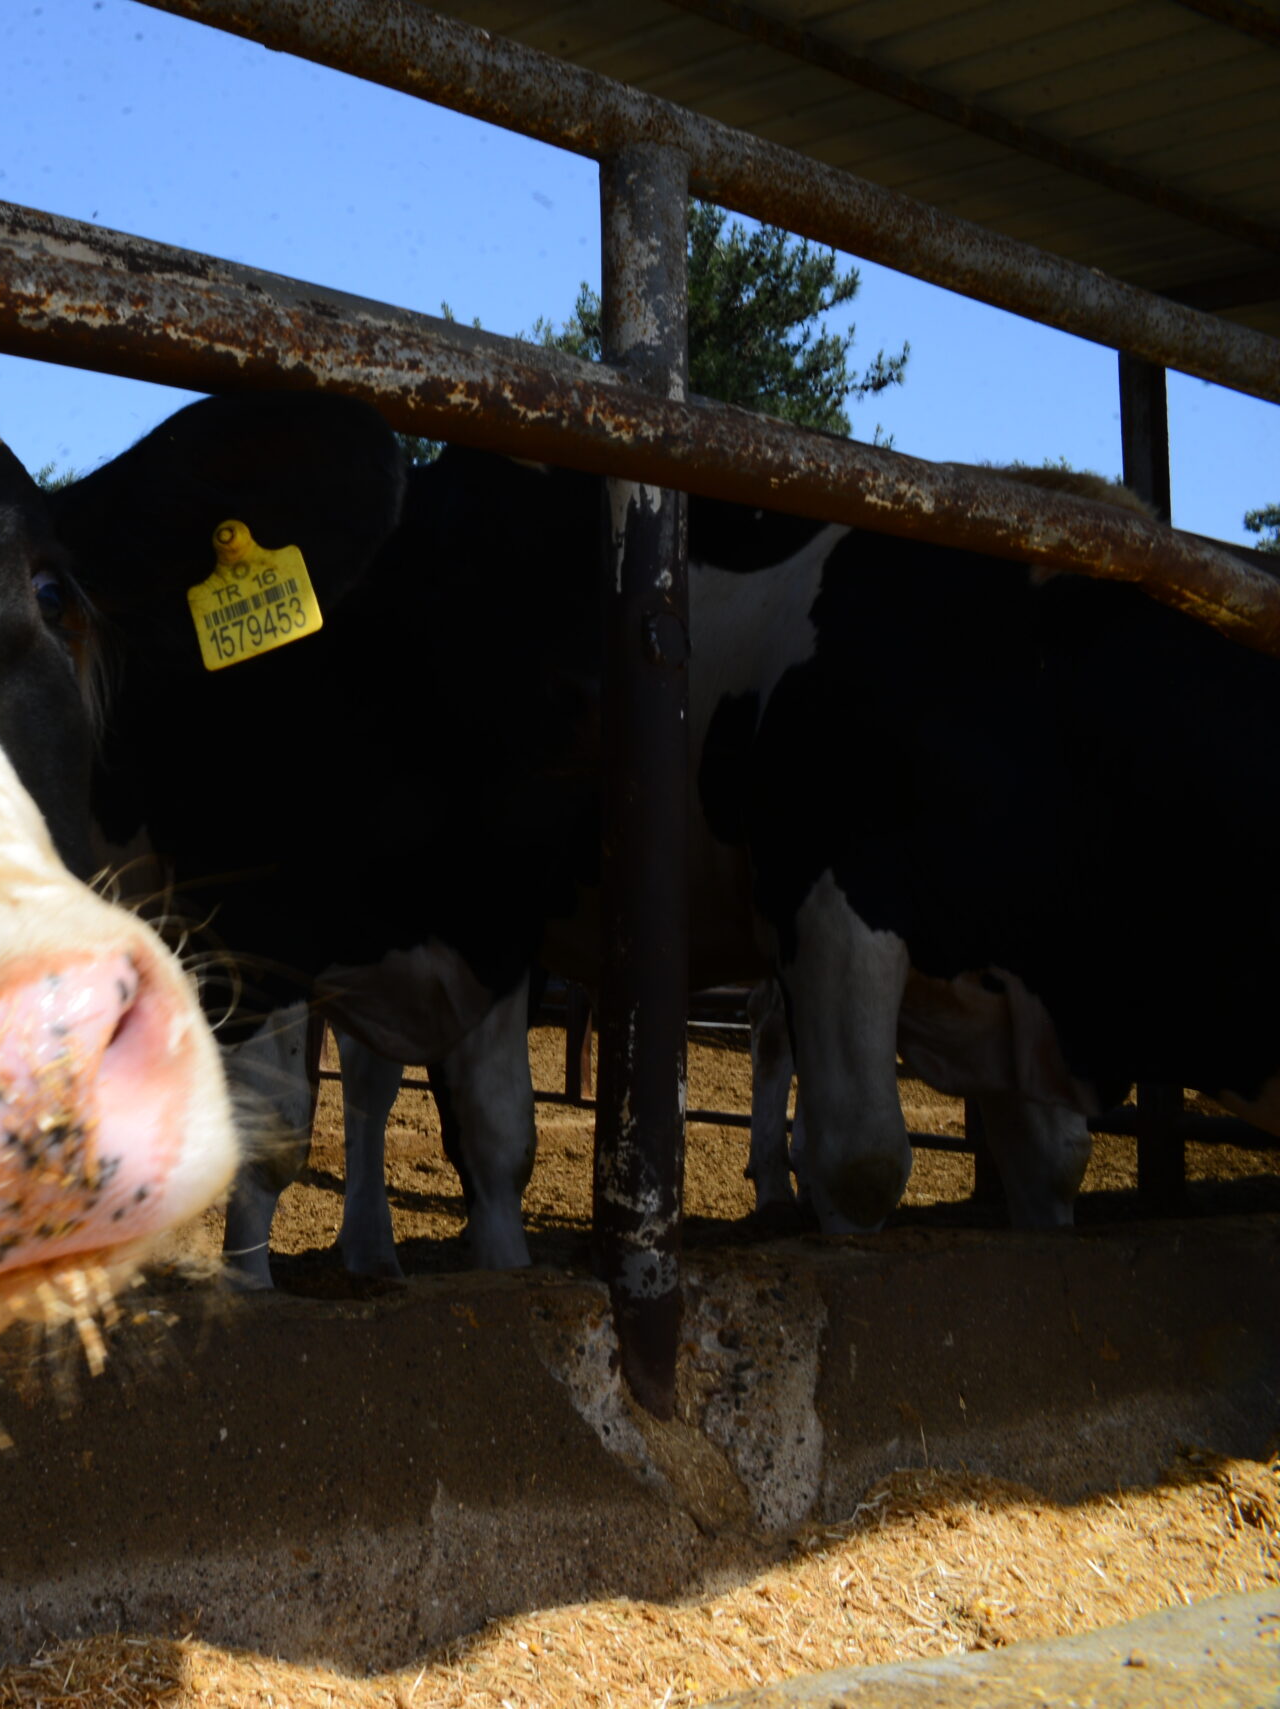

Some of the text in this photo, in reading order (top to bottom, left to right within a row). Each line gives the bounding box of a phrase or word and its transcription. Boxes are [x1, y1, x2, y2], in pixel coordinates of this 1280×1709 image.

[212, 568, 277, 605] TR 16
[209, 596, 307, 661] 1579453
